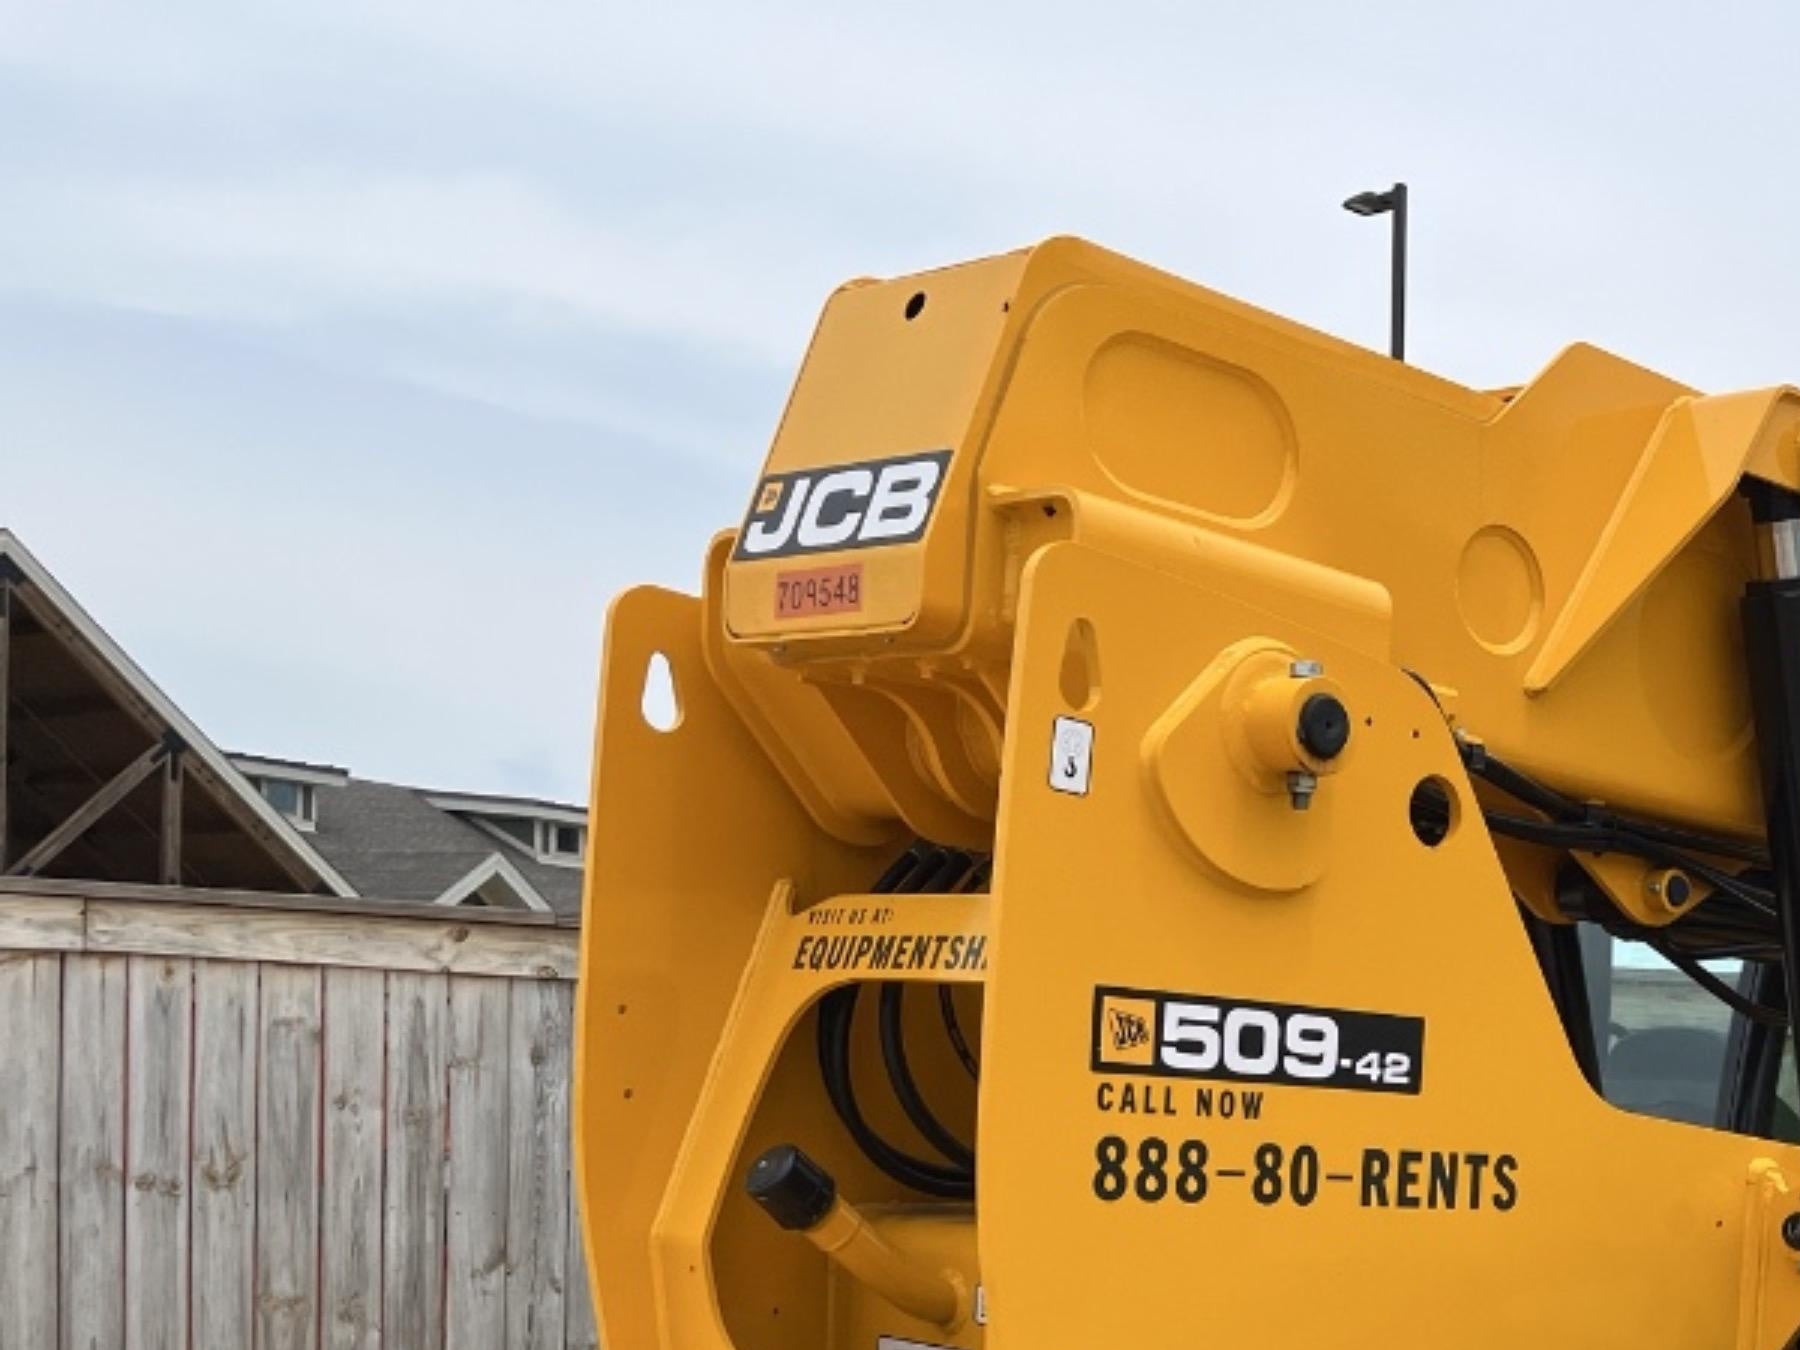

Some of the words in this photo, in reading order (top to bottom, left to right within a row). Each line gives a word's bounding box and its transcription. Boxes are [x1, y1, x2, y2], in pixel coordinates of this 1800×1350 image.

[743, 460, 940, 553] JCB
[777, 572, 861, 612] 709548
[808, 908, 846, 925] VISIT
[848, 908, 868, 925] US
[791, 935, 988, 972] EQUIPMENTSH
[1160, 1002, 1412, 1085] 509-42
[1096, 1082, 1177, 1117] CALL
[1196, 1088, 1264, 1120] NOW
[1092, 1135, 1520, 1212] 888-80-RENTS
